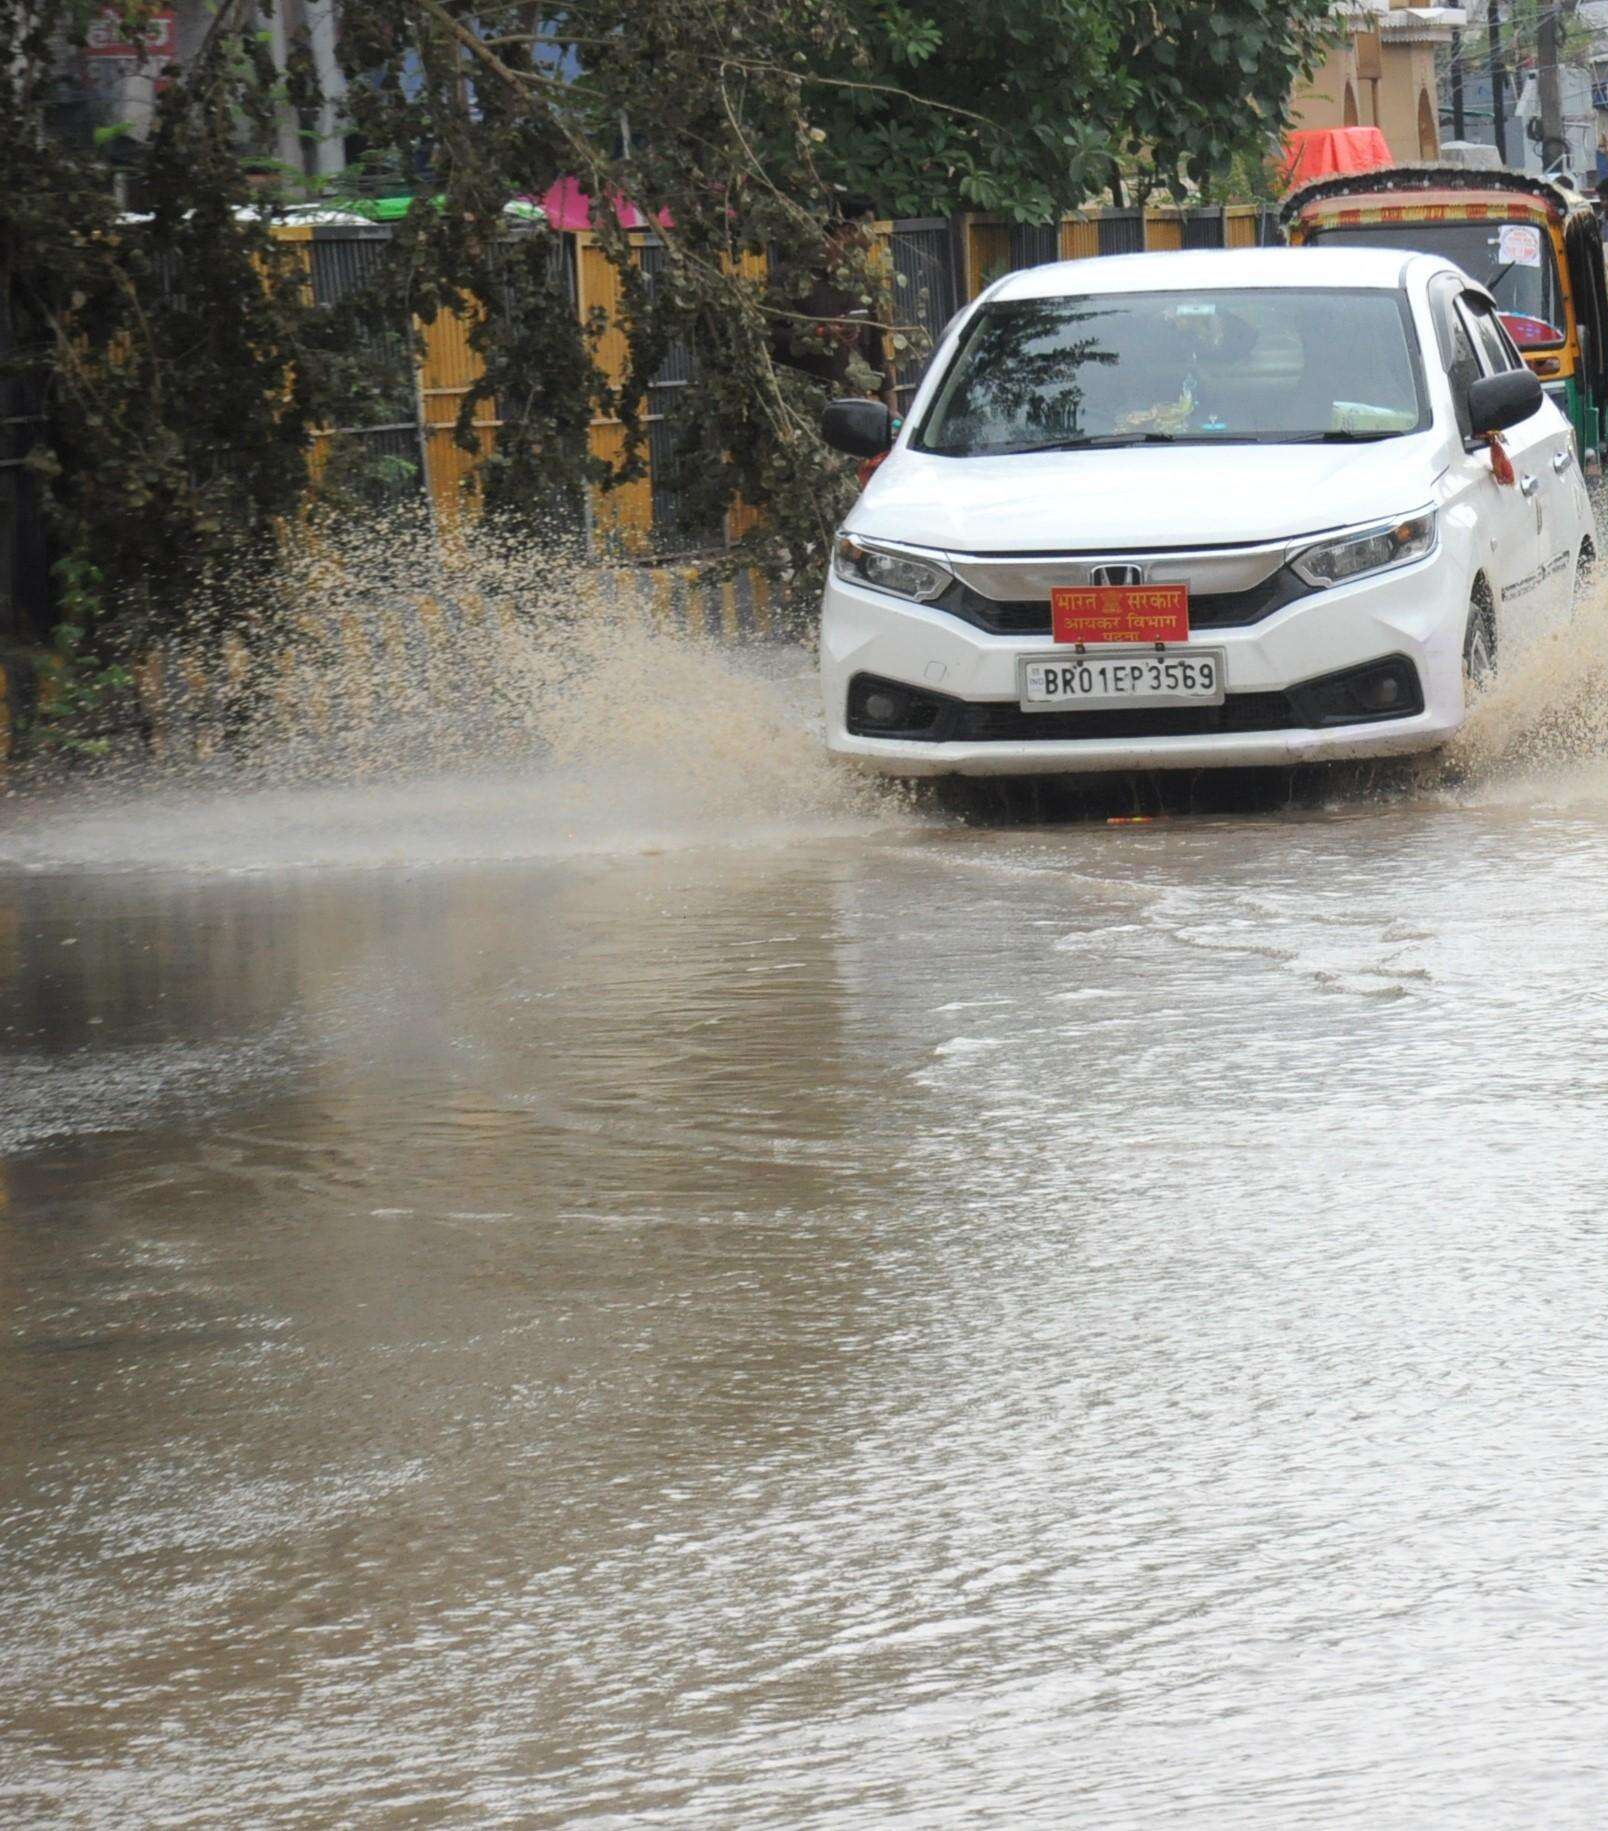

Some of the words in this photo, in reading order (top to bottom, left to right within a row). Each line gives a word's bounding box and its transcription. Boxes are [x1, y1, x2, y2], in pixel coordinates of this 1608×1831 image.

[1056, 593, 1097, 610] भारत
[1125, 591, 1182, 609] सरकार
[1063, 616, 1121, 630] आयकर
[1126, 612, 1178, 629] विभाग
[1103, 631, 1141, 642] पटना
[1044, 663, 1214, 695] BR01EP3569
